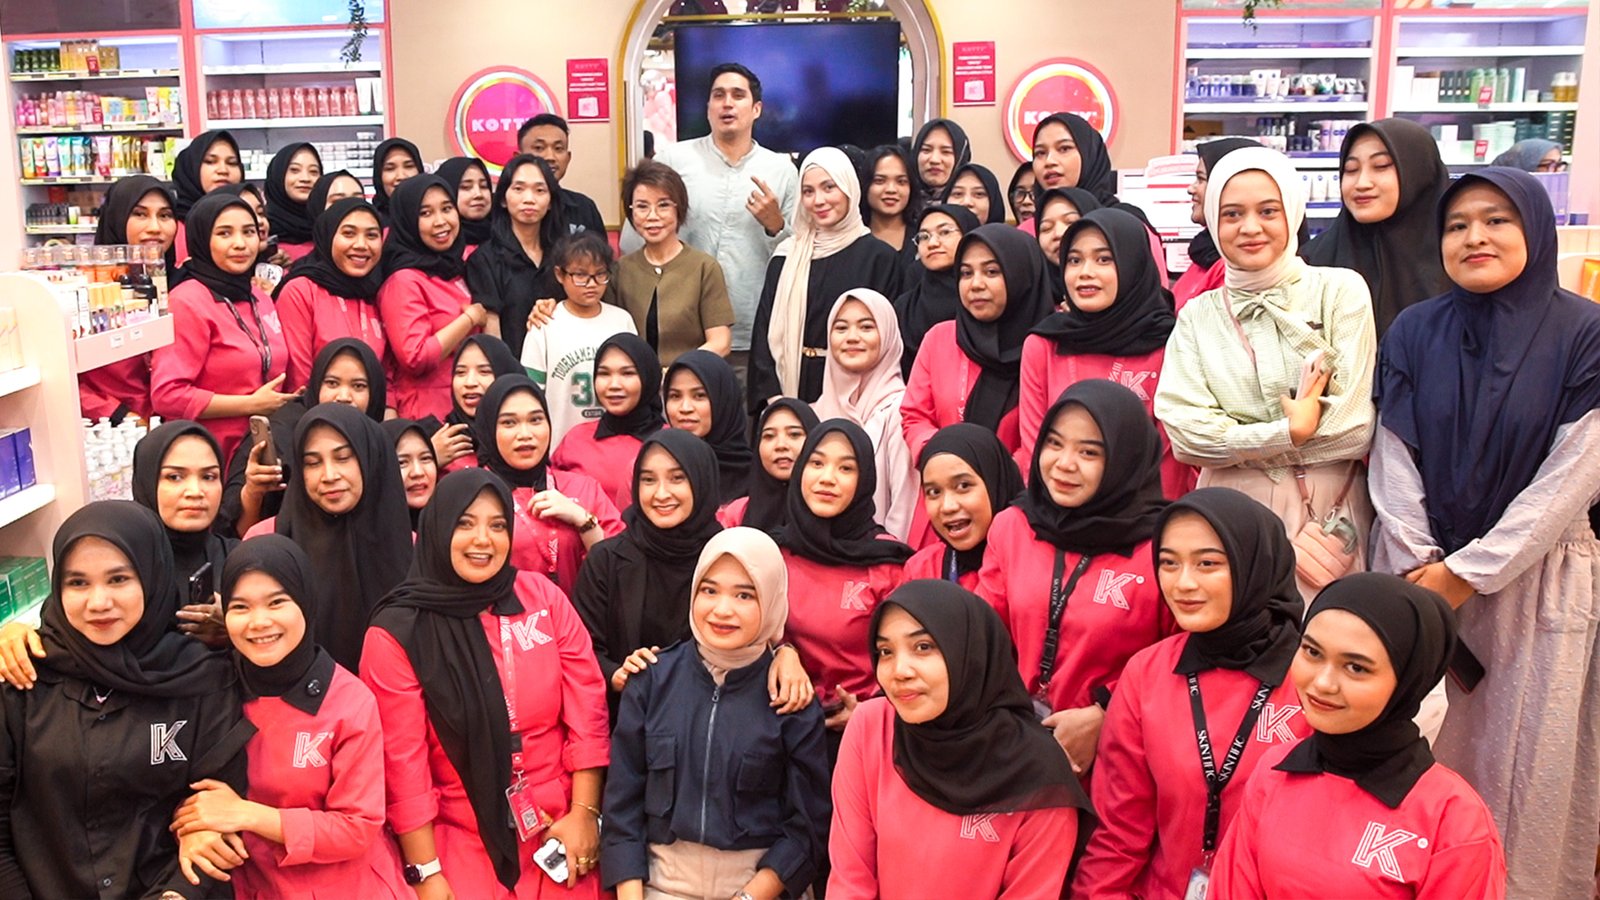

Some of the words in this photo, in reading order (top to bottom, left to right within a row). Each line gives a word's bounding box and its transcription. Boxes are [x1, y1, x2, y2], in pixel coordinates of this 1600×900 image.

[472, 118, 531, 132] KOTT
[571, 371, 599, 408] 3
[1121, 371, 1151, 400] K
[840, 581, 869, 610] K
[1093, 568, 1136, 610] K
[510, 612, 553, 652] K
[1257, 703, 1302, 743] K
[151, 720, 188, 765] K
[293, 731, 329, 768] K
[960, 812, 999, 842] K
[1352, 821, 1418, 883] K
